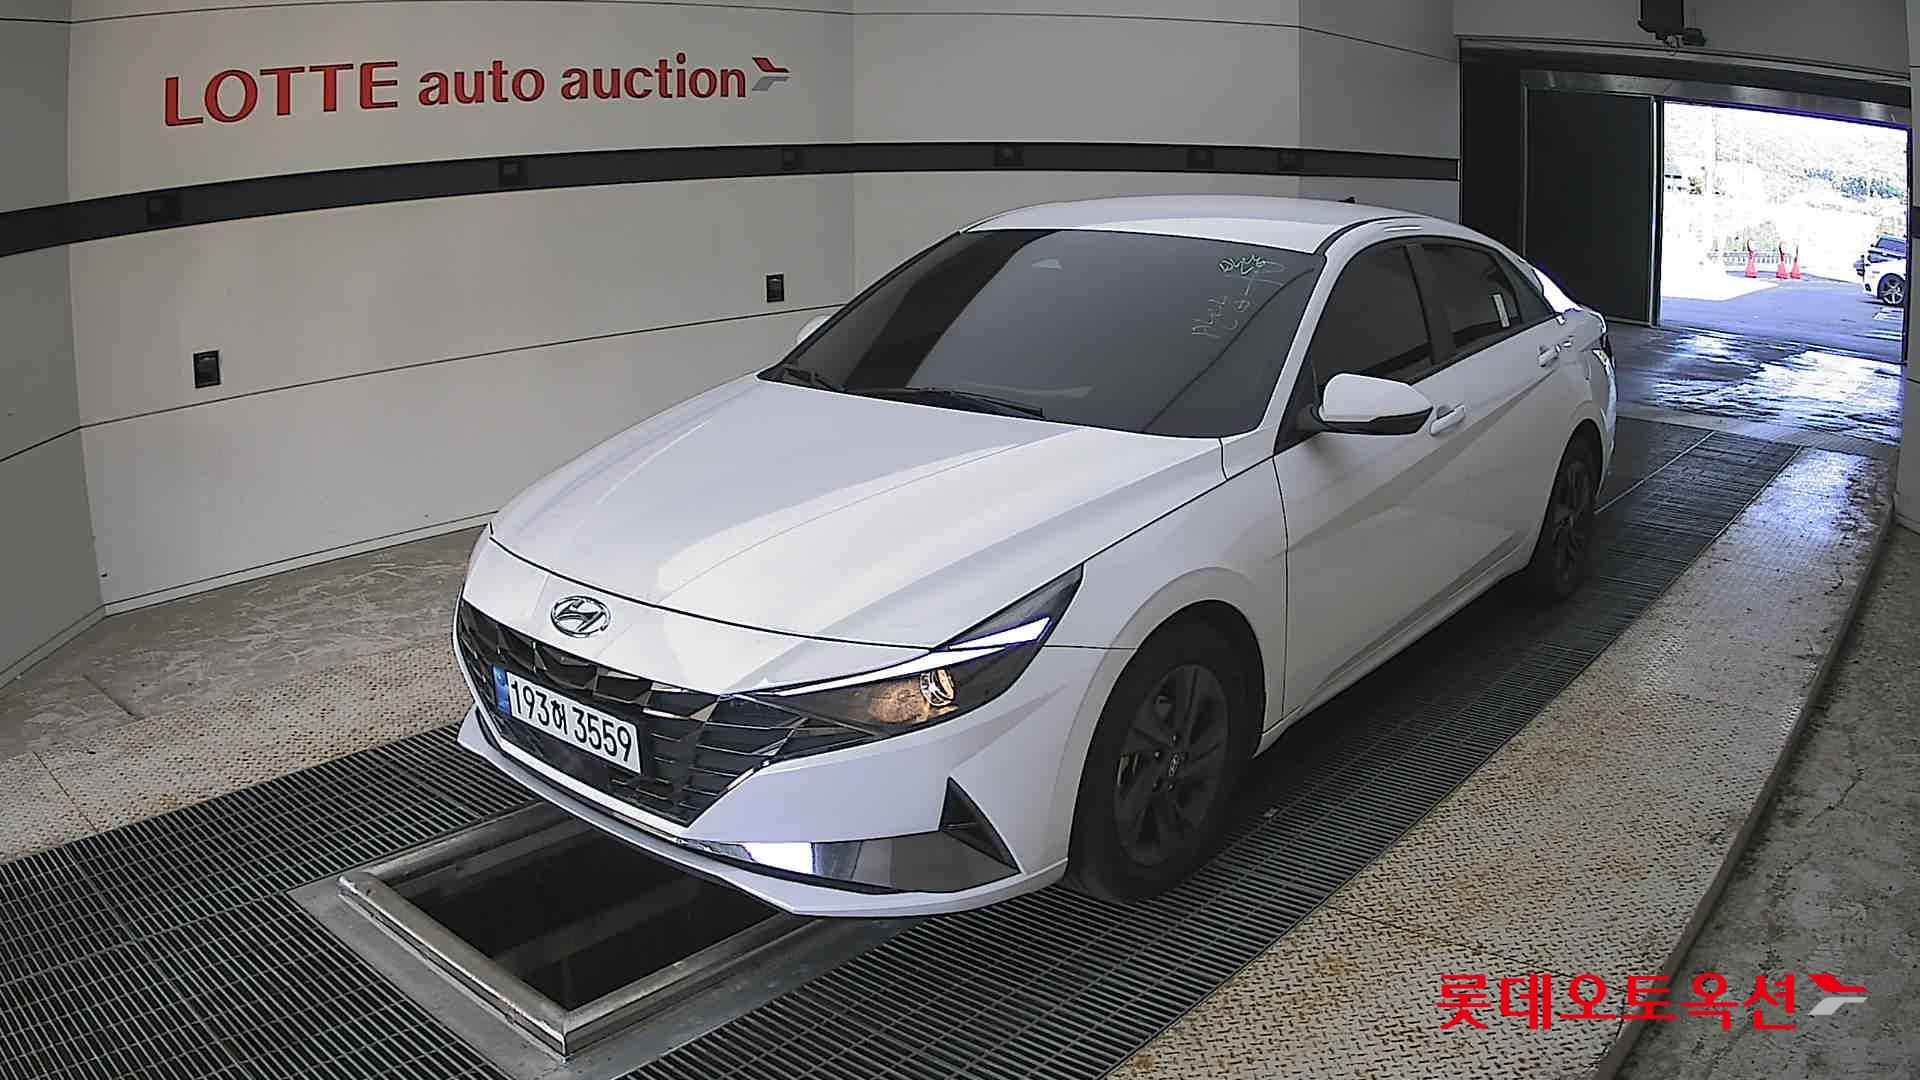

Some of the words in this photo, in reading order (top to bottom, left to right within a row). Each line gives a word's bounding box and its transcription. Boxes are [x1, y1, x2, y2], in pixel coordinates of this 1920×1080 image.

[165, 61, 398, 126] LOTTE
[418, 60, 545, 106] auto
[561, 52, 746, 100] auction
[511, 680, 569, 735] 193허
[572, 706, 632, 762] 3559
